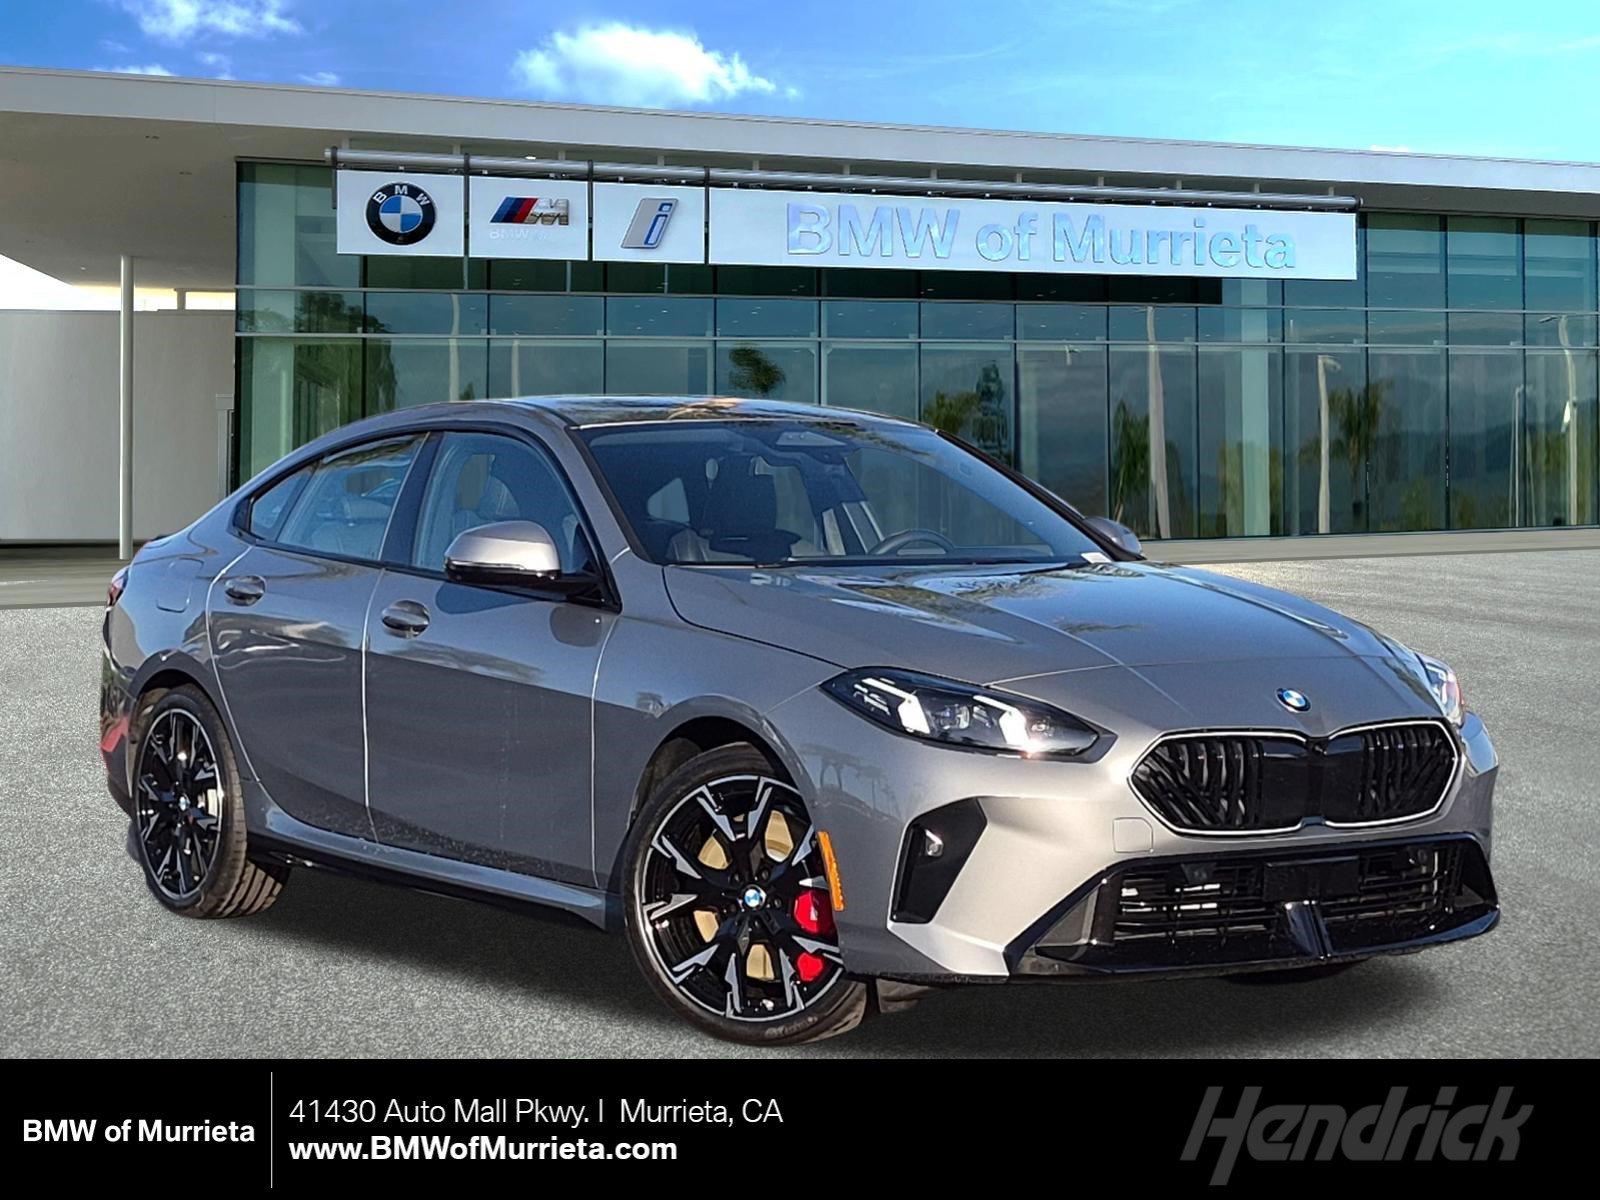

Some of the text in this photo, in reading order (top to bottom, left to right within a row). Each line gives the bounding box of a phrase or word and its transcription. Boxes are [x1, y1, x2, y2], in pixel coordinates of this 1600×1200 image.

[373, 185, 430, 206] BMW
[787, 203, 1296, 269] BMW of Murrieta
